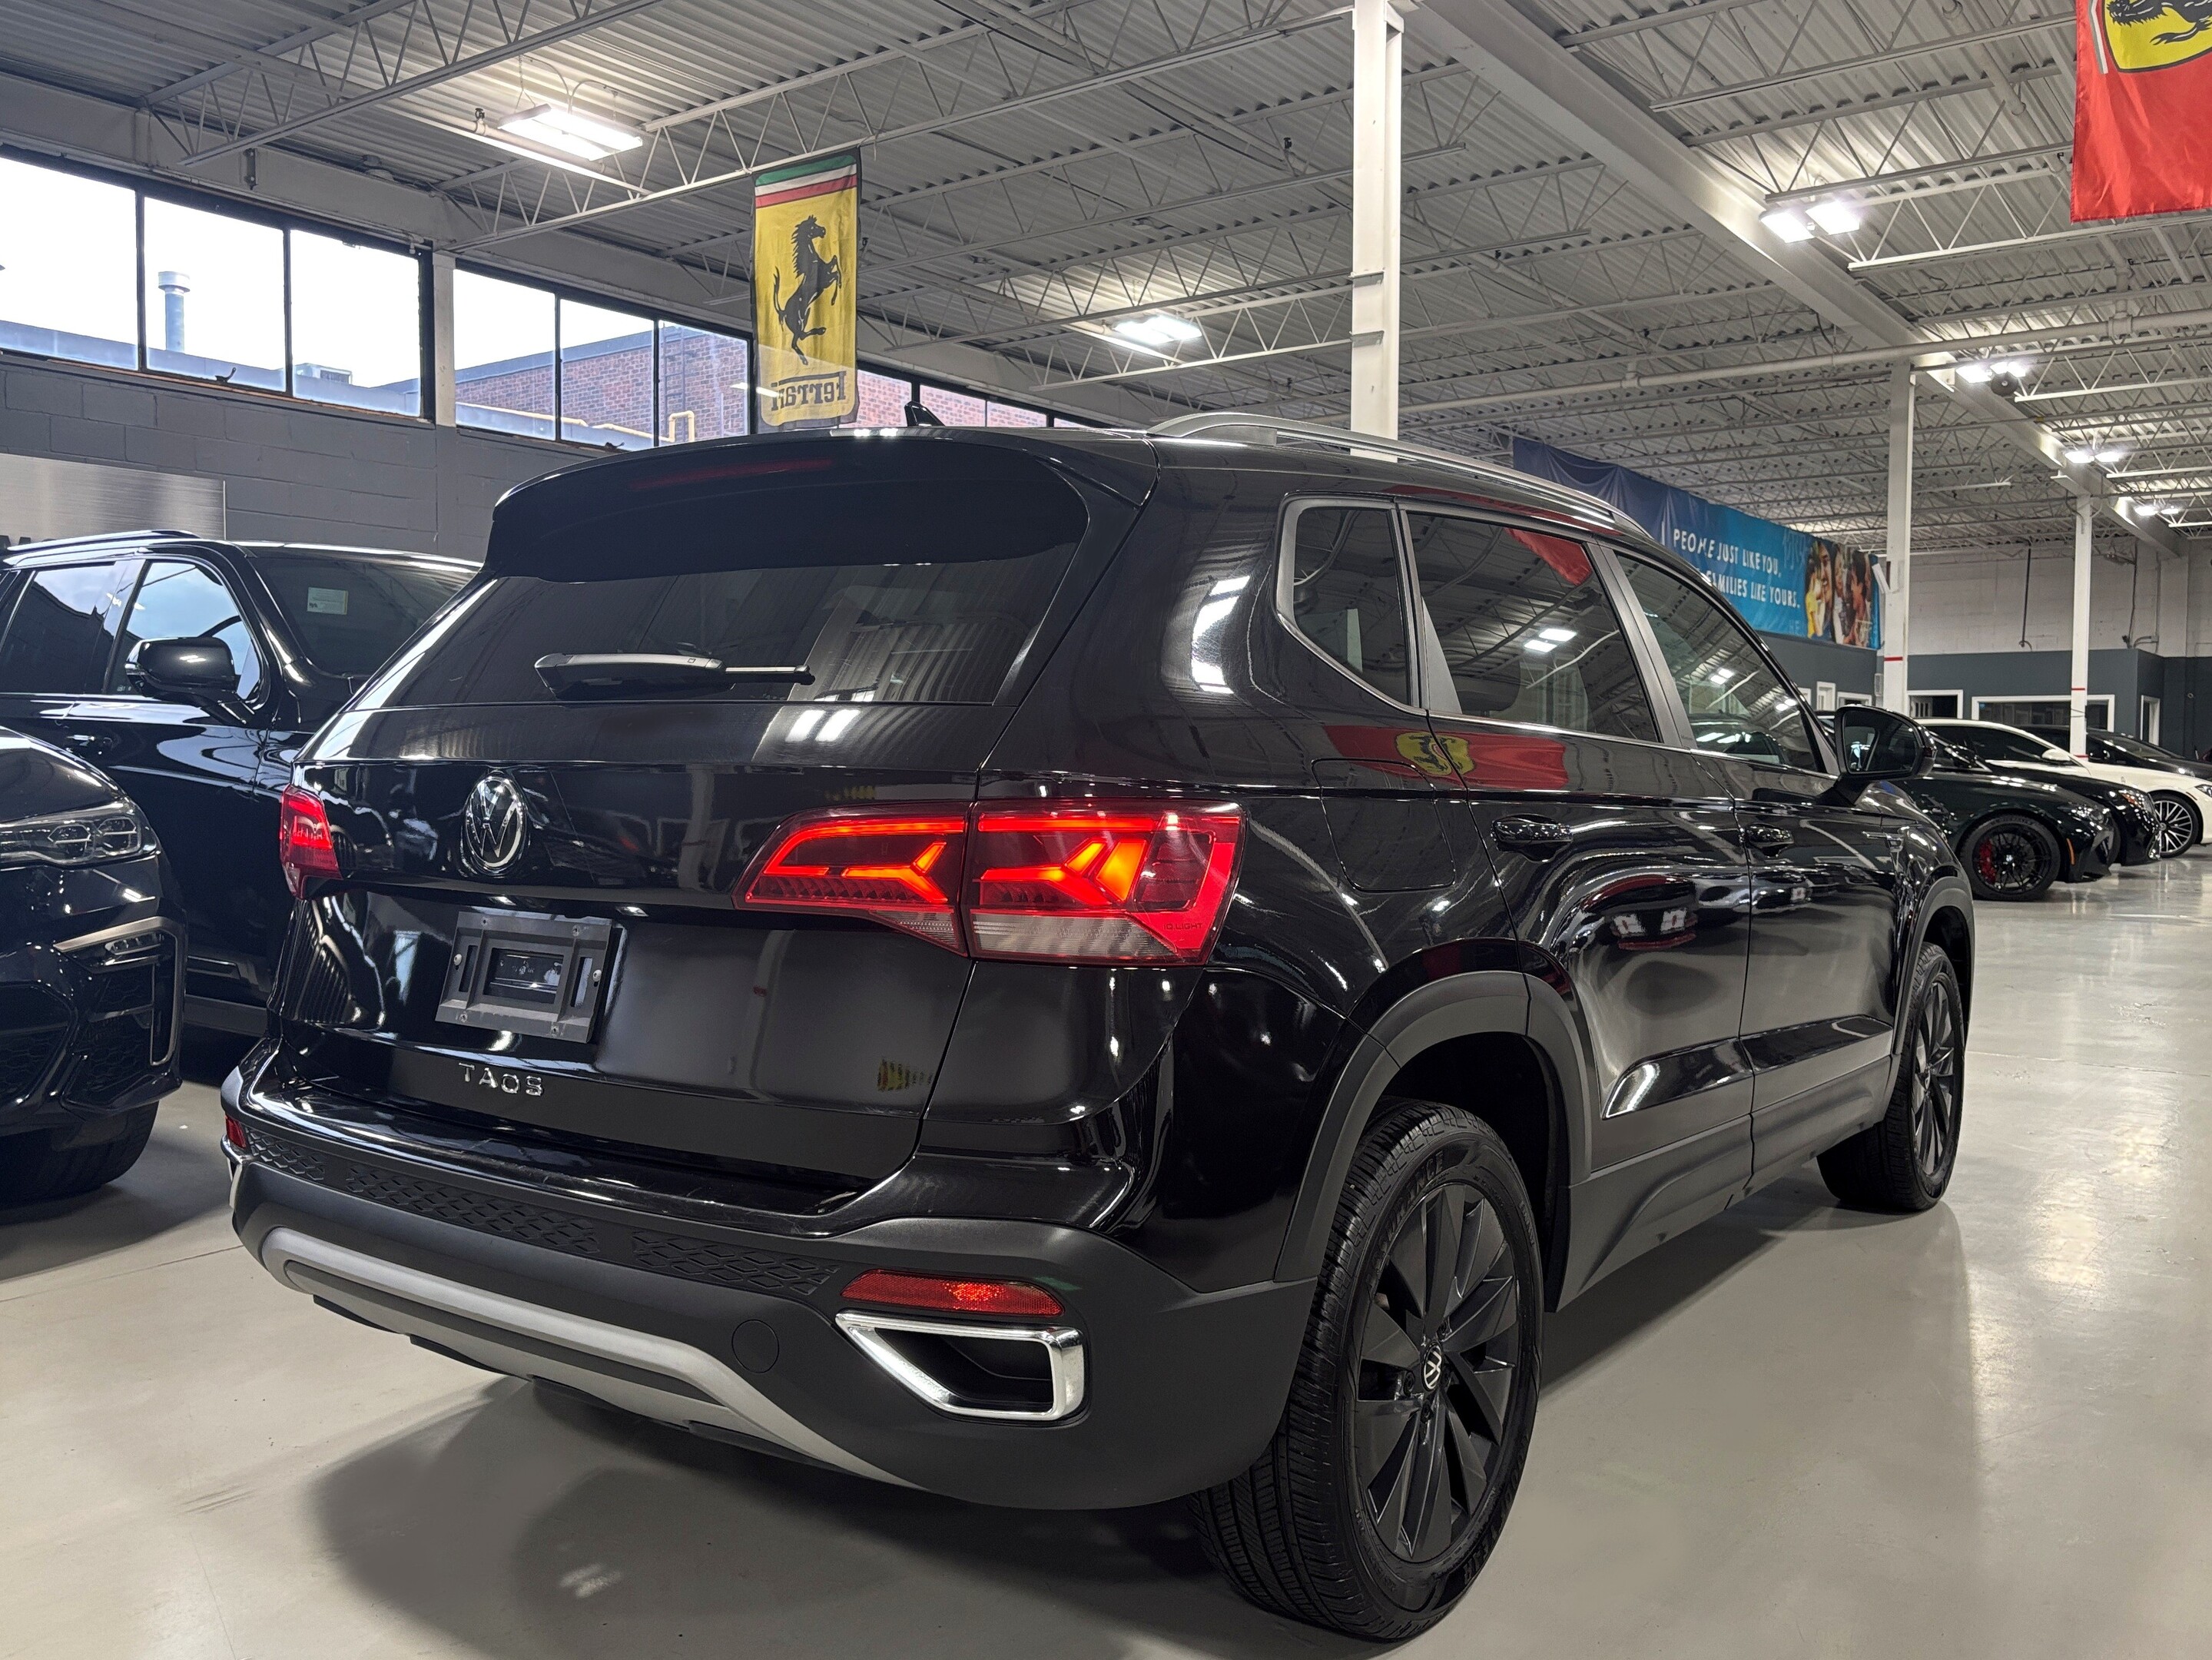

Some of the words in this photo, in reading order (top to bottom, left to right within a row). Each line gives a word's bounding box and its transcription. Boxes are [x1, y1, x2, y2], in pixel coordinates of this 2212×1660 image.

[1717, 543, 1739, 564] JUST
[1743, 549, 1759, 570] LIKE
[1762, 555, 1782, 577] YOU.
[1751, 582, 1766, 603] LIKE
[1769, 588, 1801, 609] YOURS.
[459, 1062, 543, 1096] TAOS
